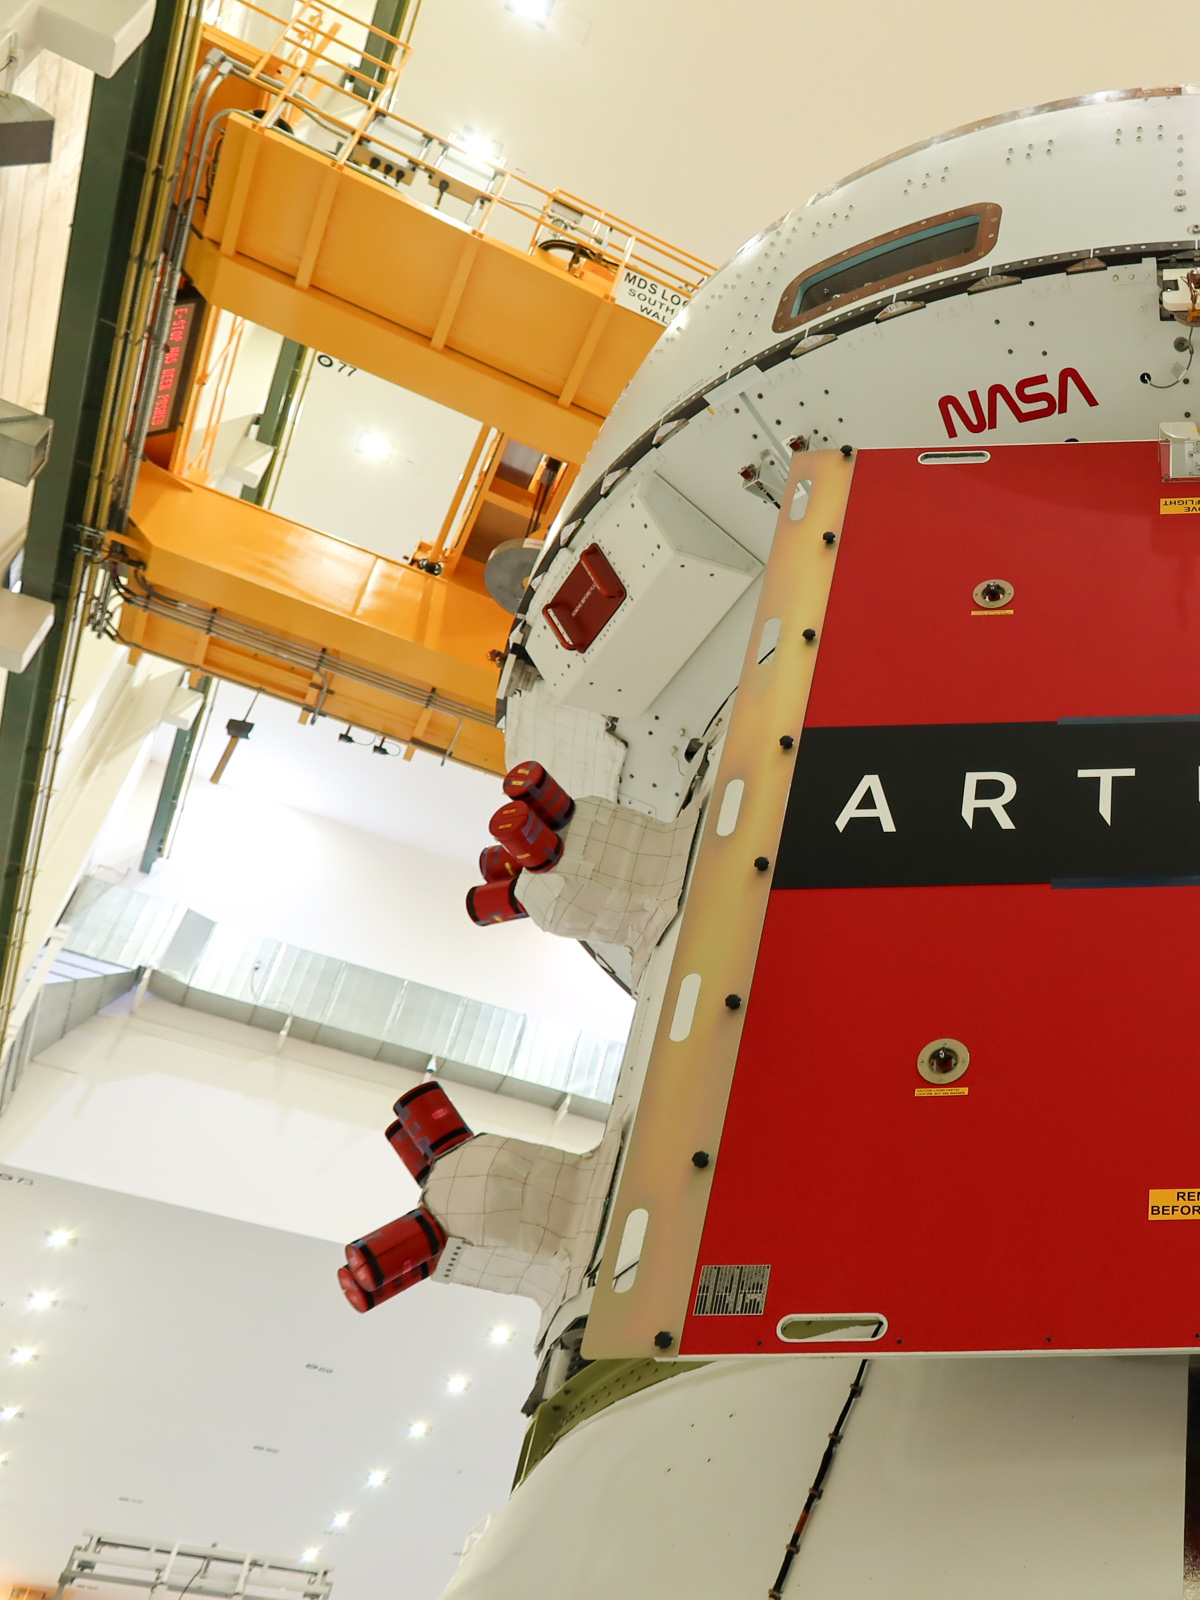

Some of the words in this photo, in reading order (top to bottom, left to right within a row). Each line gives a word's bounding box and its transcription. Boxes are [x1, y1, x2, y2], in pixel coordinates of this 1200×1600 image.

[624, 272, 658, 295] MDS
[628, 288, 675, 315] SOUTH
[168, 307, 190, 342] E-STOP
[151, 394, 171, 426] PUSHED
[939, 368, 1098, 438] NASA
